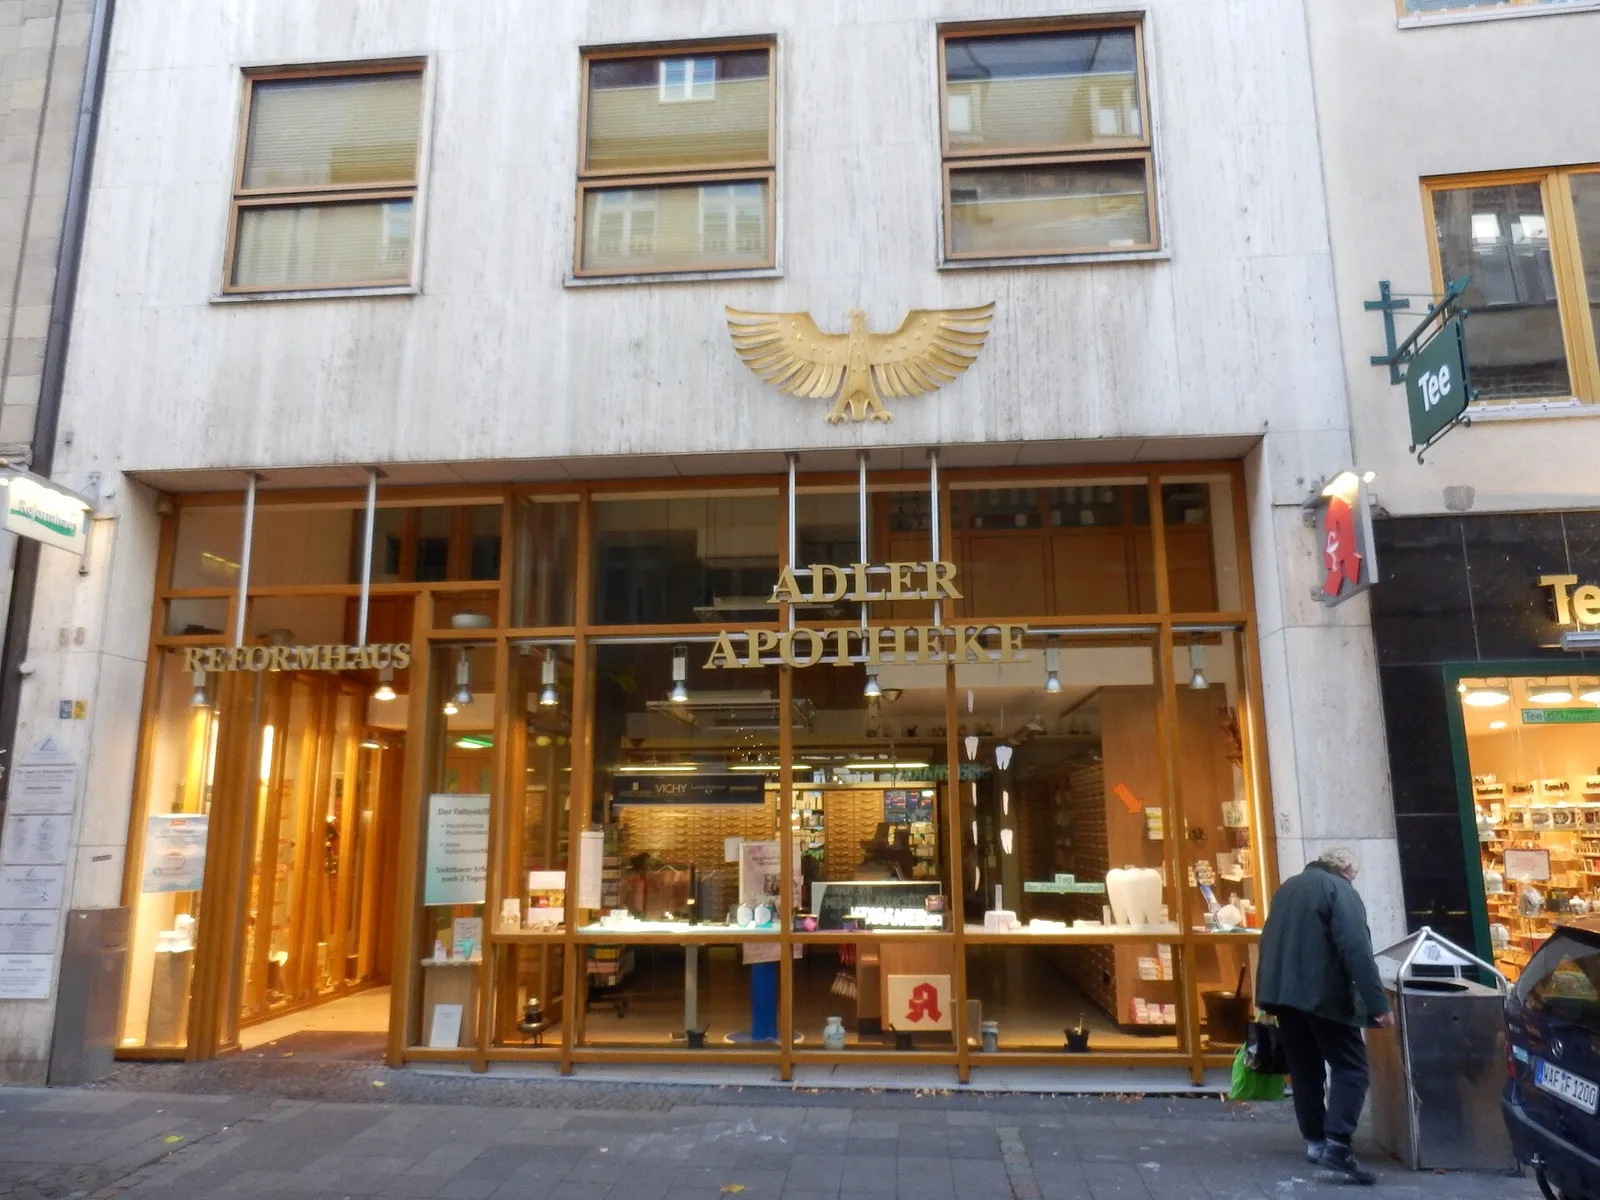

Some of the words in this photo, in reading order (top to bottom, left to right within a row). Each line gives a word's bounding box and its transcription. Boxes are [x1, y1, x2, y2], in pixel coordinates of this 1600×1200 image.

[1418, 364, 1451, 412] Tee
[767, 561, 963, 604] ADLER
[184, 643, 412, 672] REFORMHAUS
[703, 623, 1032, 669] APOTHEKE
[655, 783, 688, 794] VICHY
[1573, 1080, 1596, 1106] 1200
